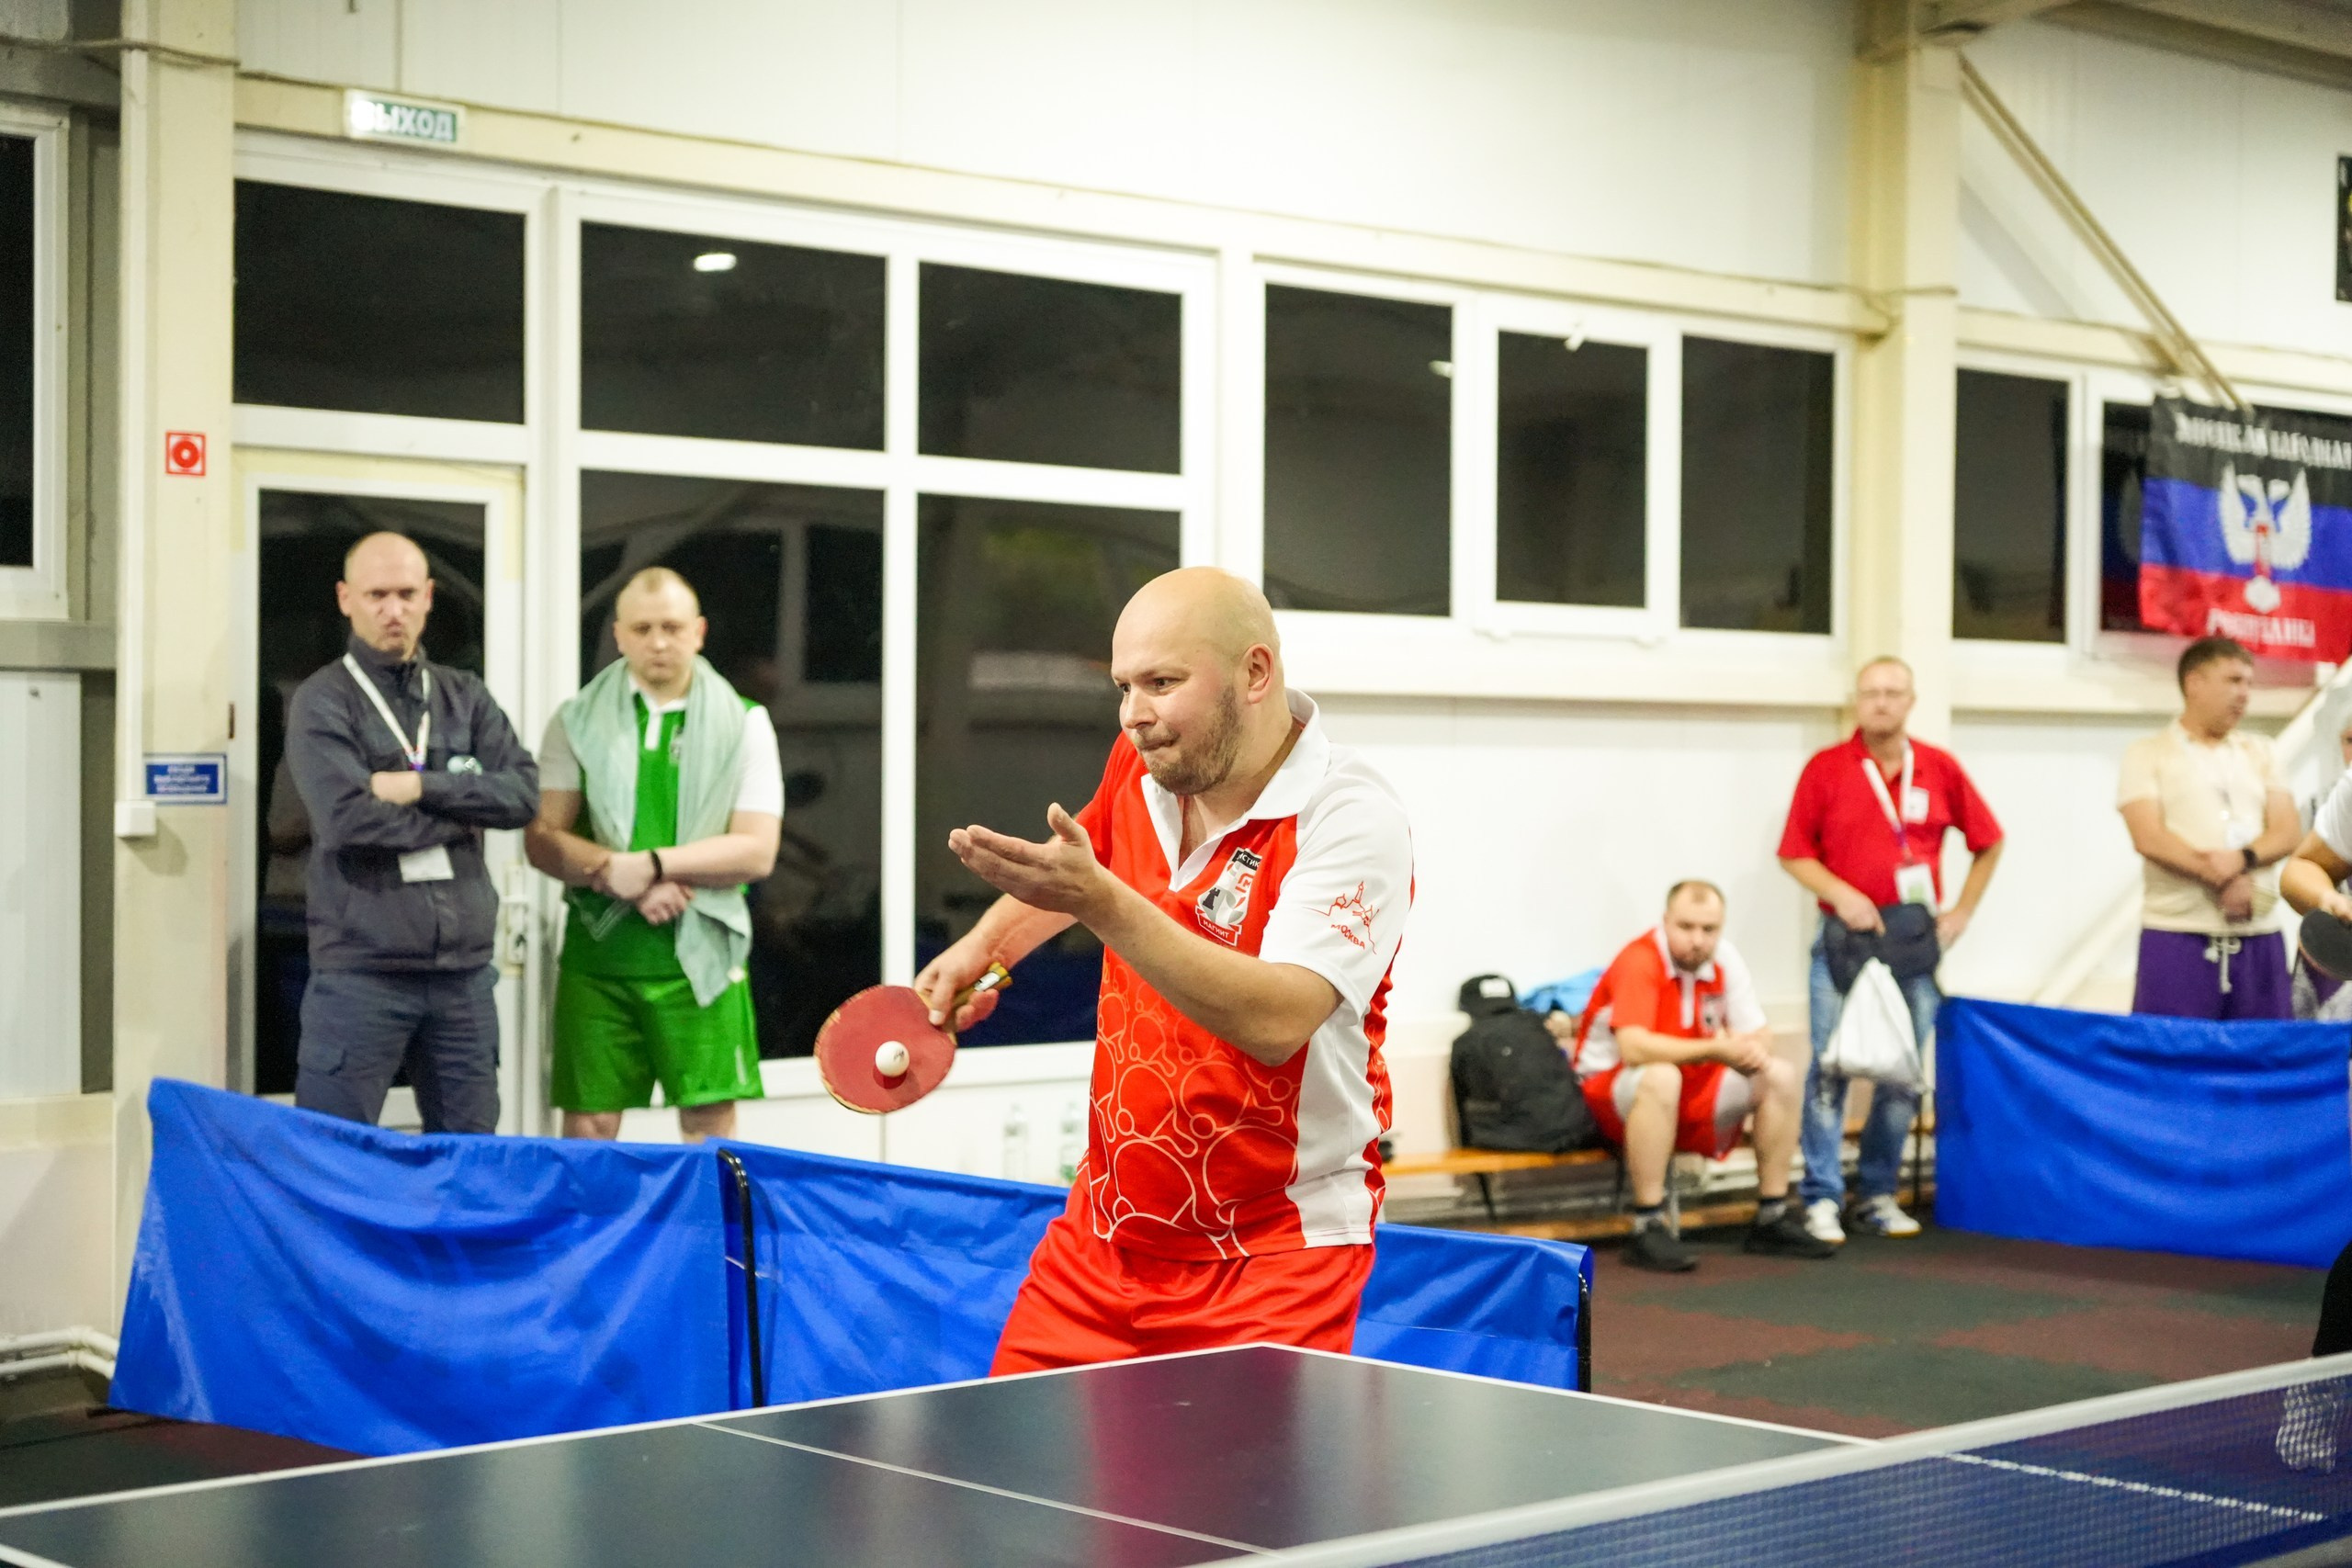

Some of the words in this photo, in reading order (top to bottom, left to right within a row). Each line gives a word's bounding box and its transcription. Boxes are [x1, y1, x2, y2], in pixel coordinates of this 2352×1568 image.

[352, 100, 454, 141] ЫХОД
[1203, 919, 1230, 939] МАГНИТ
[1331, 924, 1365, 950] МОСКВА
